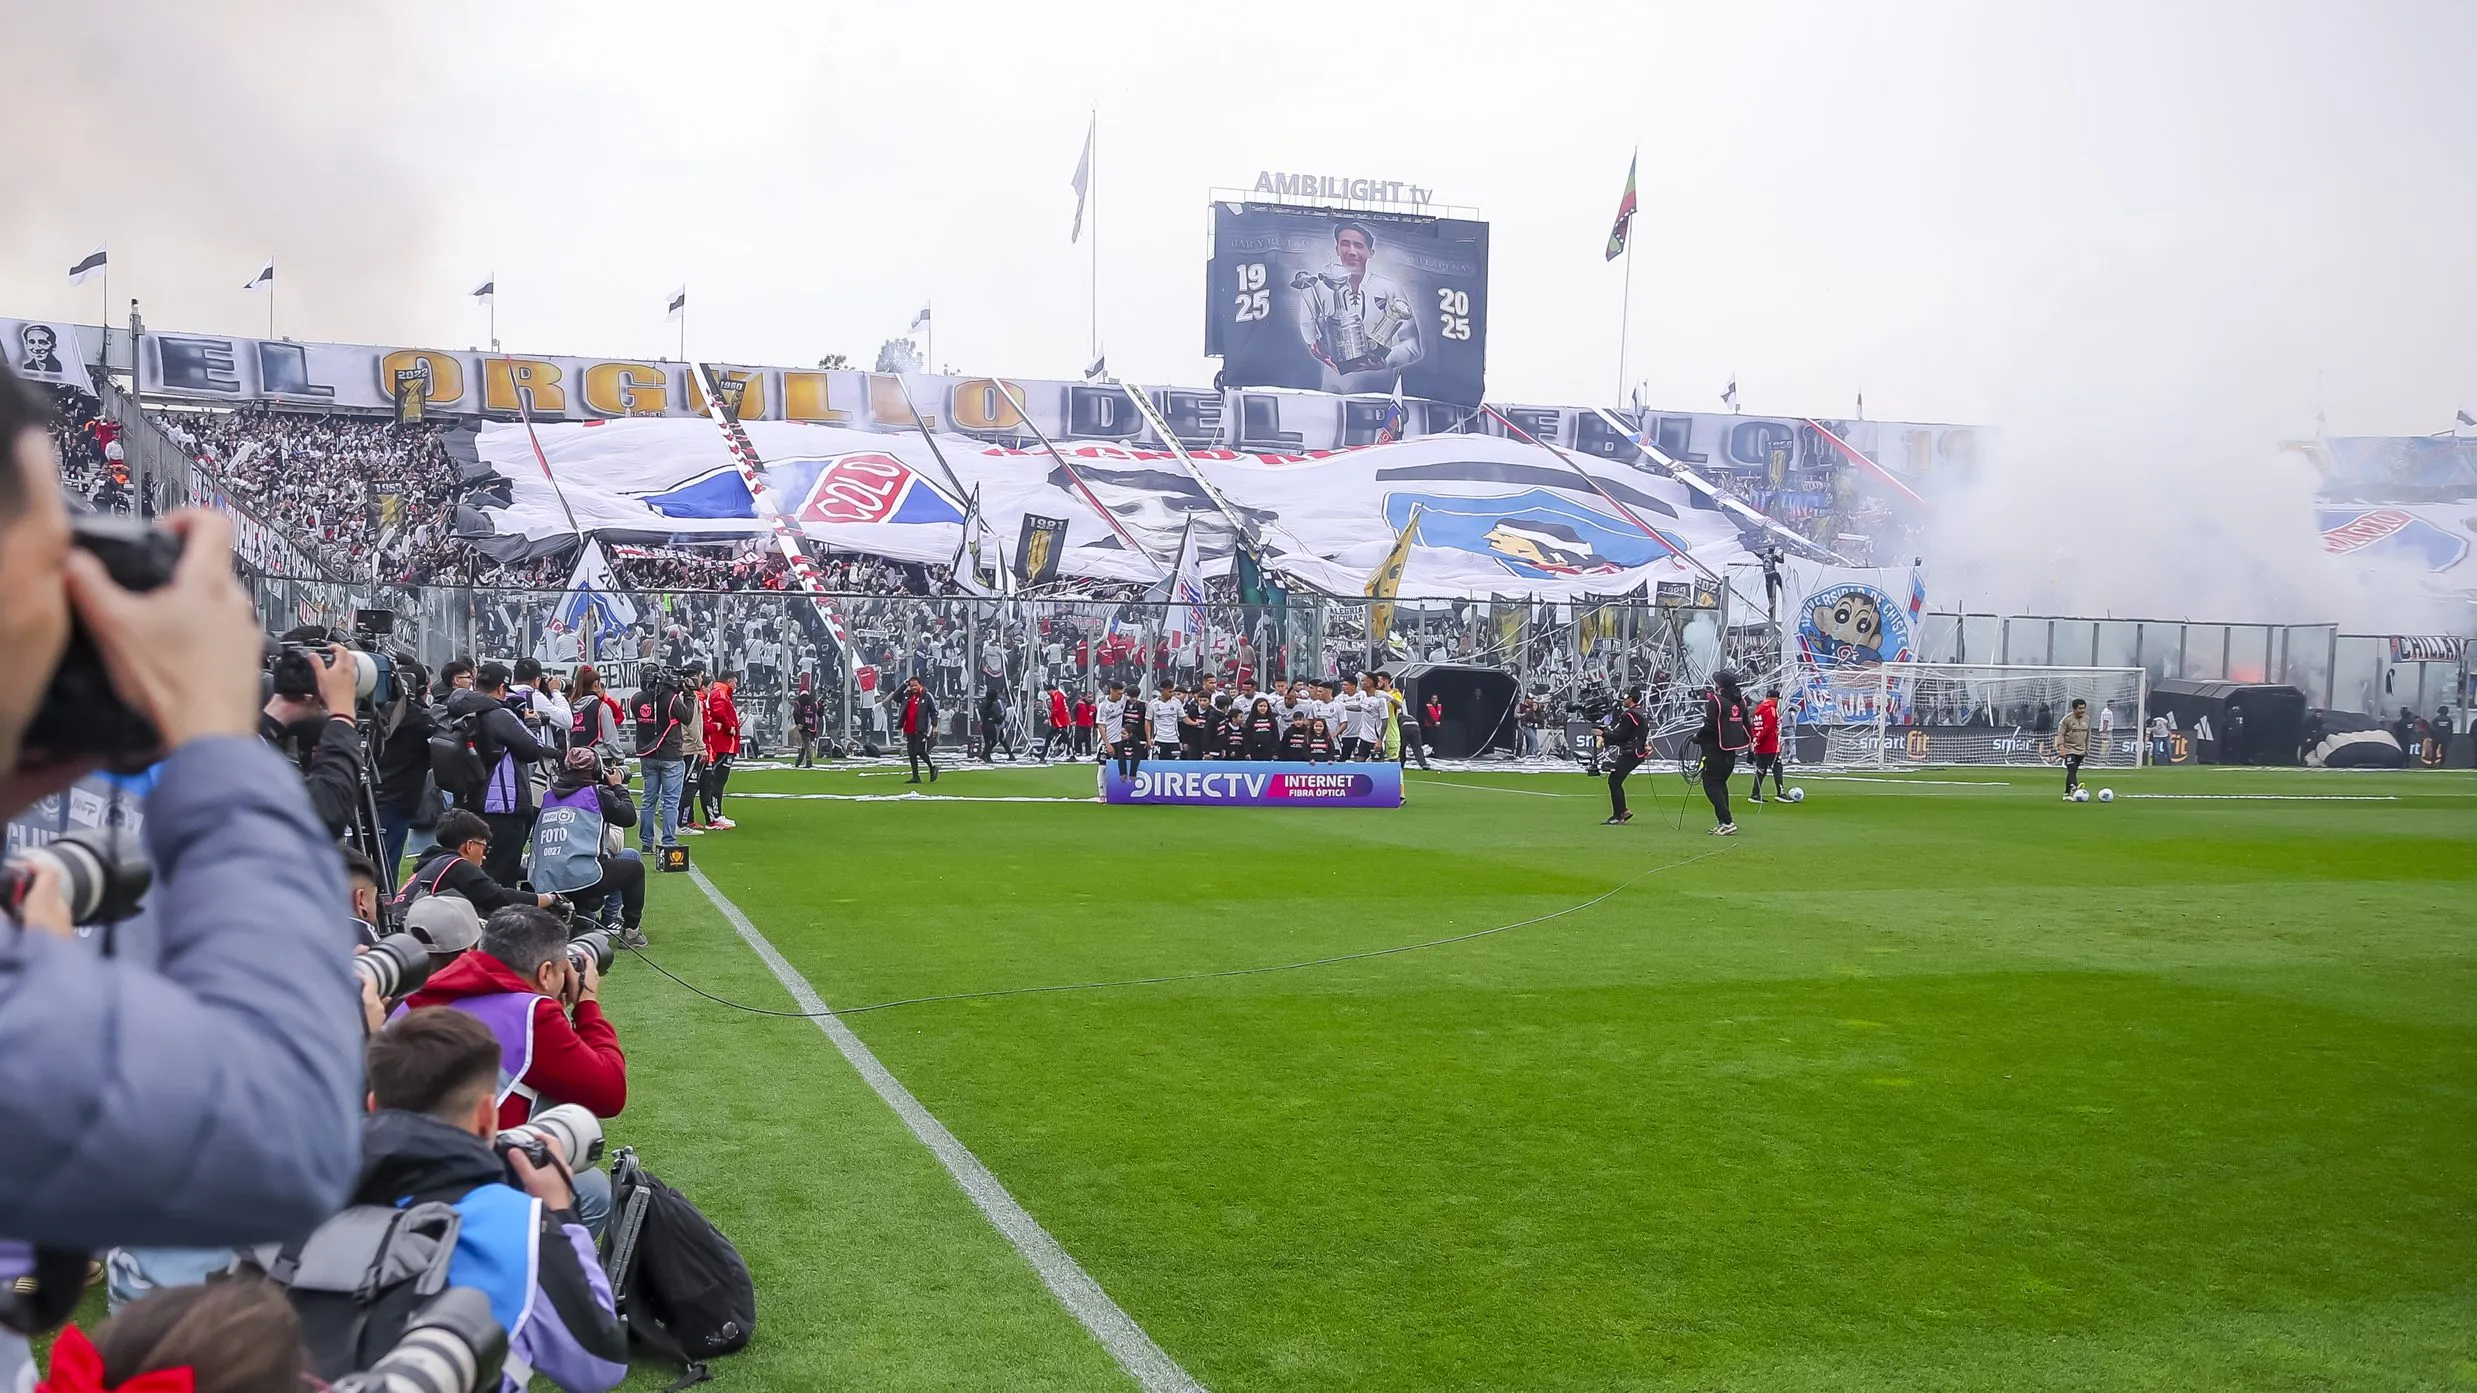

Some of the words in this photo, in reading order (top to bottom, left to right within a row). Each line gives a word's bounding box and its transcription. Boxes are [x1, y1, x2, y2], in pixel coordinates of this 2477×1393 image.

[1254, 170, 1404, 204] AMBILIGHT
[1409, 184, 1433, 205] tv
[1235, 263, 1267, 292] 19
[1234, 289, 1270, 322] 25
[1437, 287, 1469, 317] 20
[1440, 313, 1471, 340] 25
[397, 367, 428, 380] 2022
[157, 336, 335, 397] EL
[382, 349, 1026, 428] ORGULLO
[1070, 386, 1304, 443] DEL
[815, 461, 901, 521] COLO
[1330, 606, 1364, 615] ALEGRIA
[1870, 590, 1886, 608] DE
[1882, 603, 1909, 646] CHISTE
[1860, 737, 1905, 750] smart
[1992, 738, 2036, 751] smar
[1130, 771, 1267, 798] DIRECTV
[1284, 774, 1355, 788] INTERNET
[1288, 790, 1314, 798] FIBRA
[1315, 787, 1346, 798] ÓPTICA
[540, 827, 567, 845] FOTO
[543, 846, 562, 857] 0027
